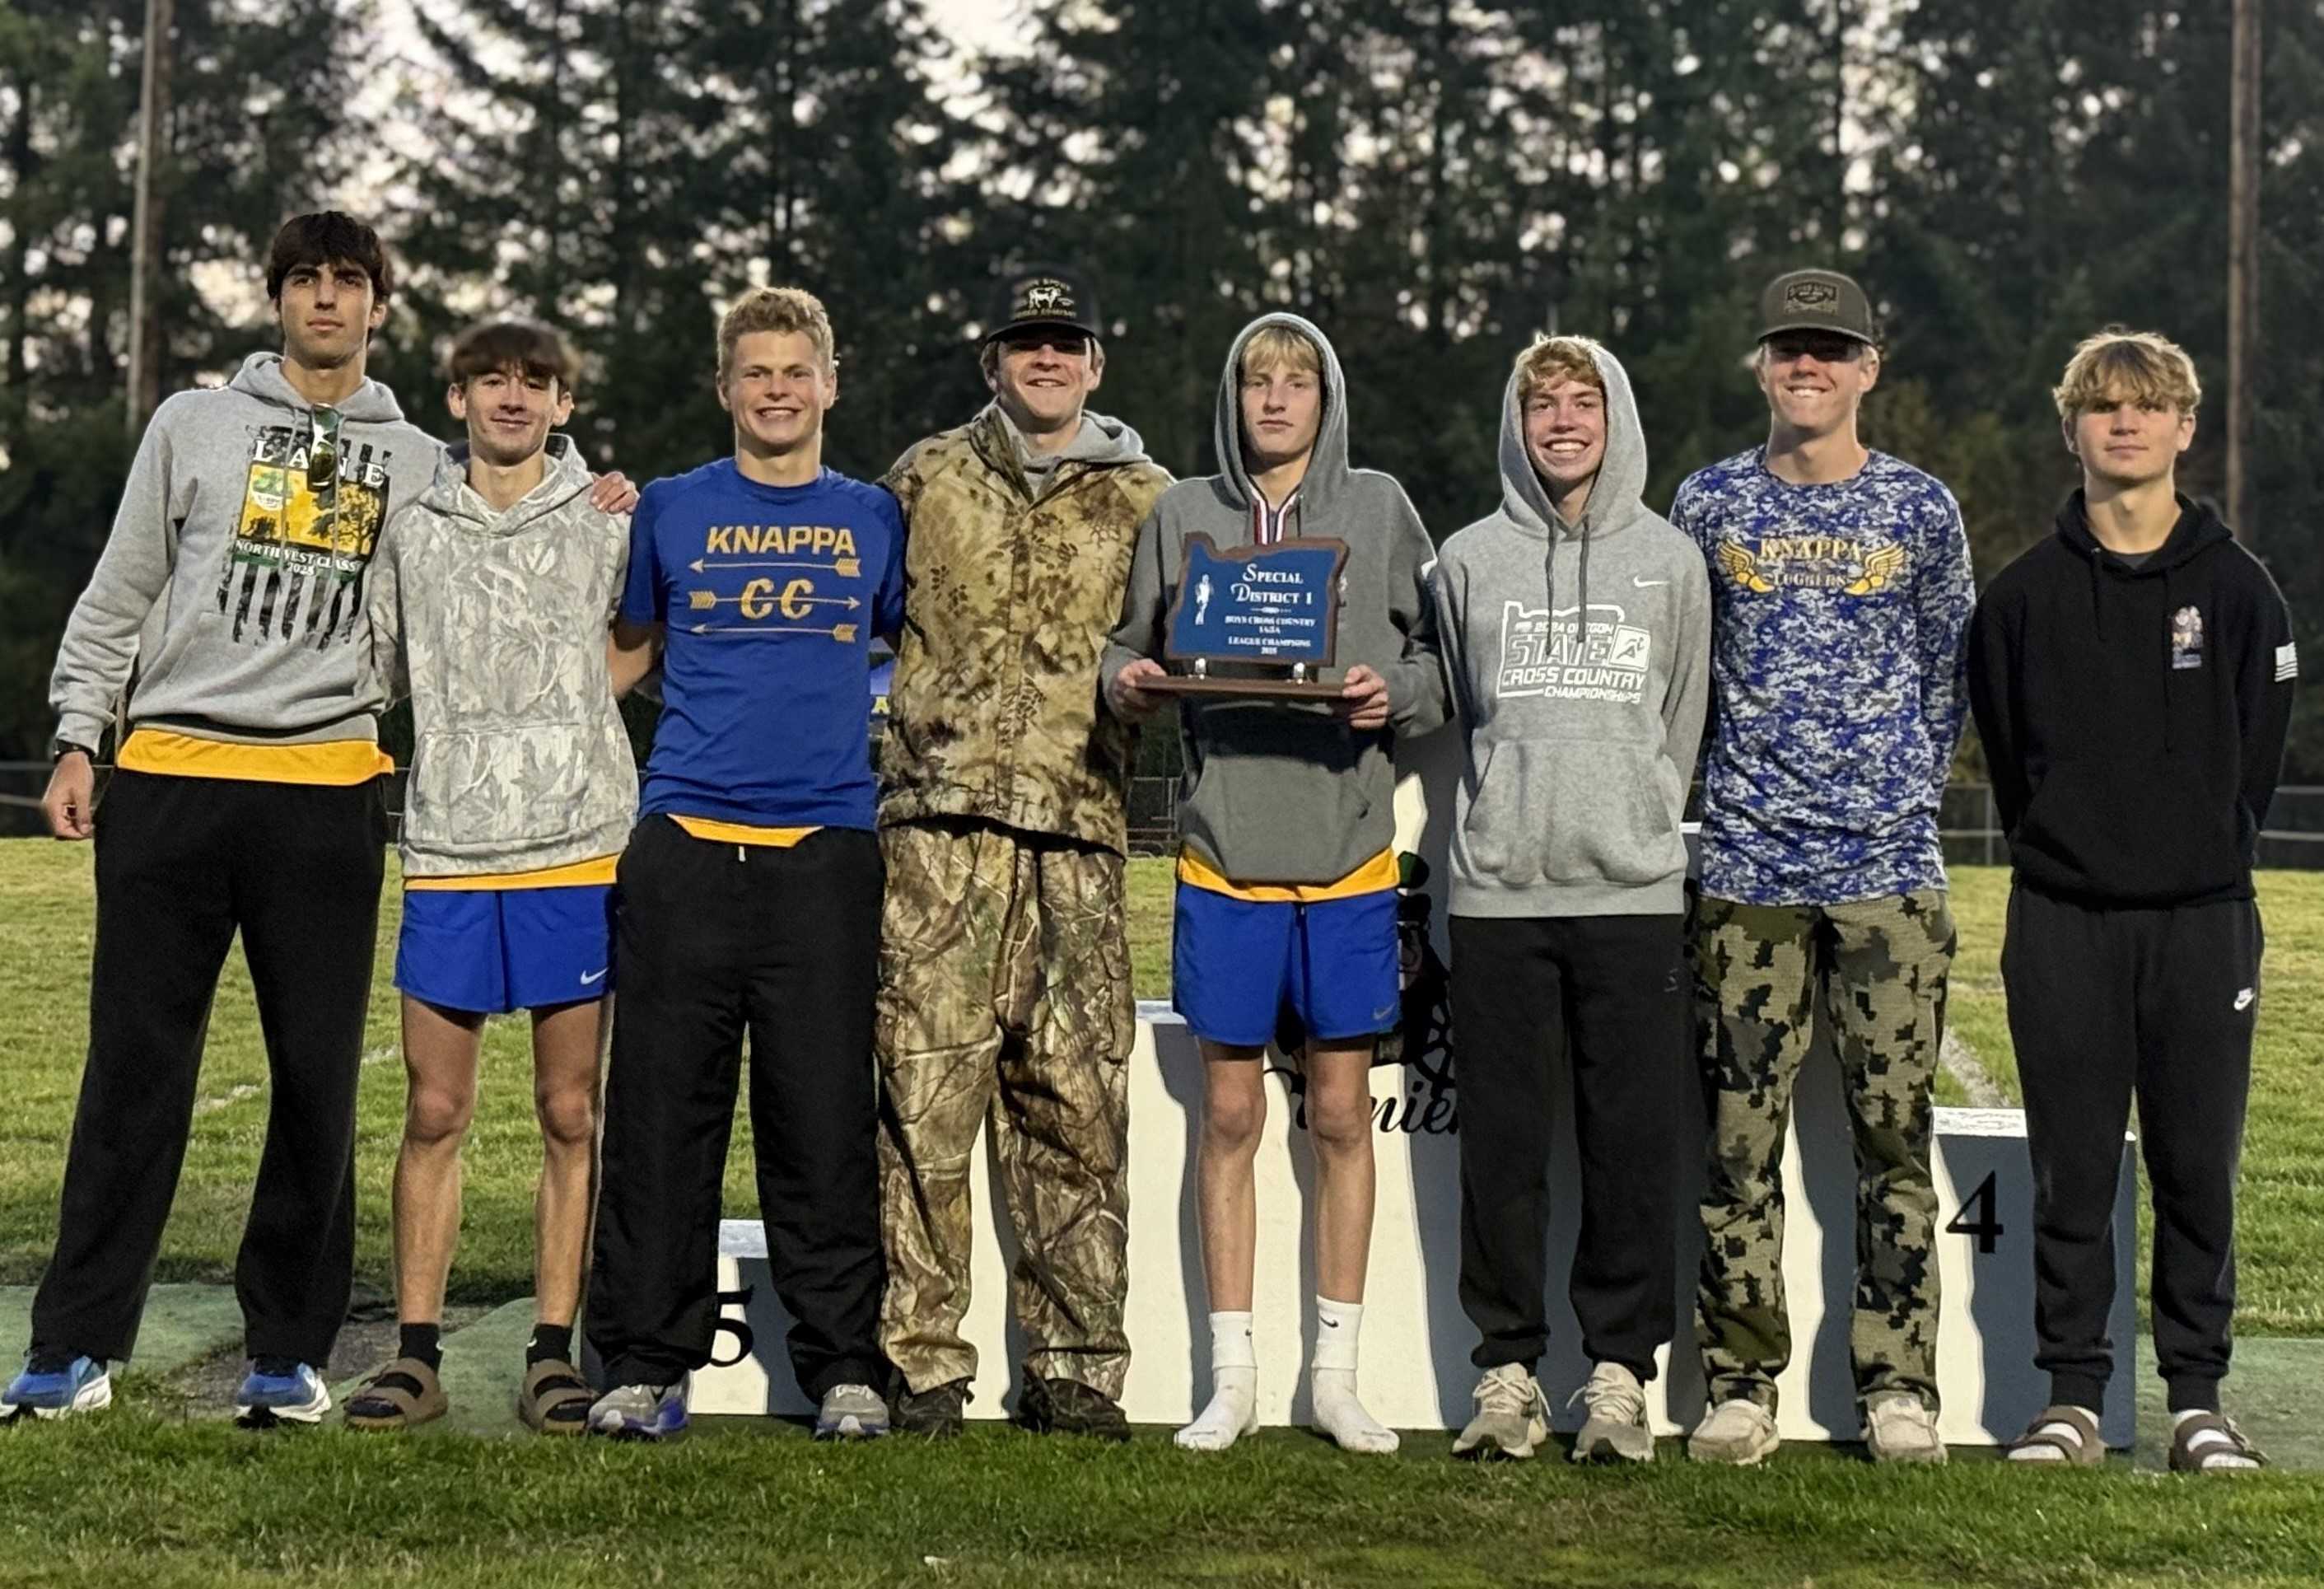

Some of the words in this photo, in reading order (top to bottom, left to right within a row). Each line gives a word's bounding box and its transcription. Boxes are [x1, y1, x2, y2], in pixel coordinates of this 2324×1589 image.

[706, 525, 856, 556] KNAPPA
[1760, 538, 1861, 560] KNAPPA
[1566, 622, 1614, 635] OGON
[1506, 633, 1612, 666] STATE
[1501, 666, 1561, 686] CROSS
[1562, 667, 1646, 690] COUNTRY
[1544, 685, 1642, 704] CHAMPIONSHIPS
[1945, 1170, 2004, 1254] 4
[710, 1283, 754, 1368] 5
